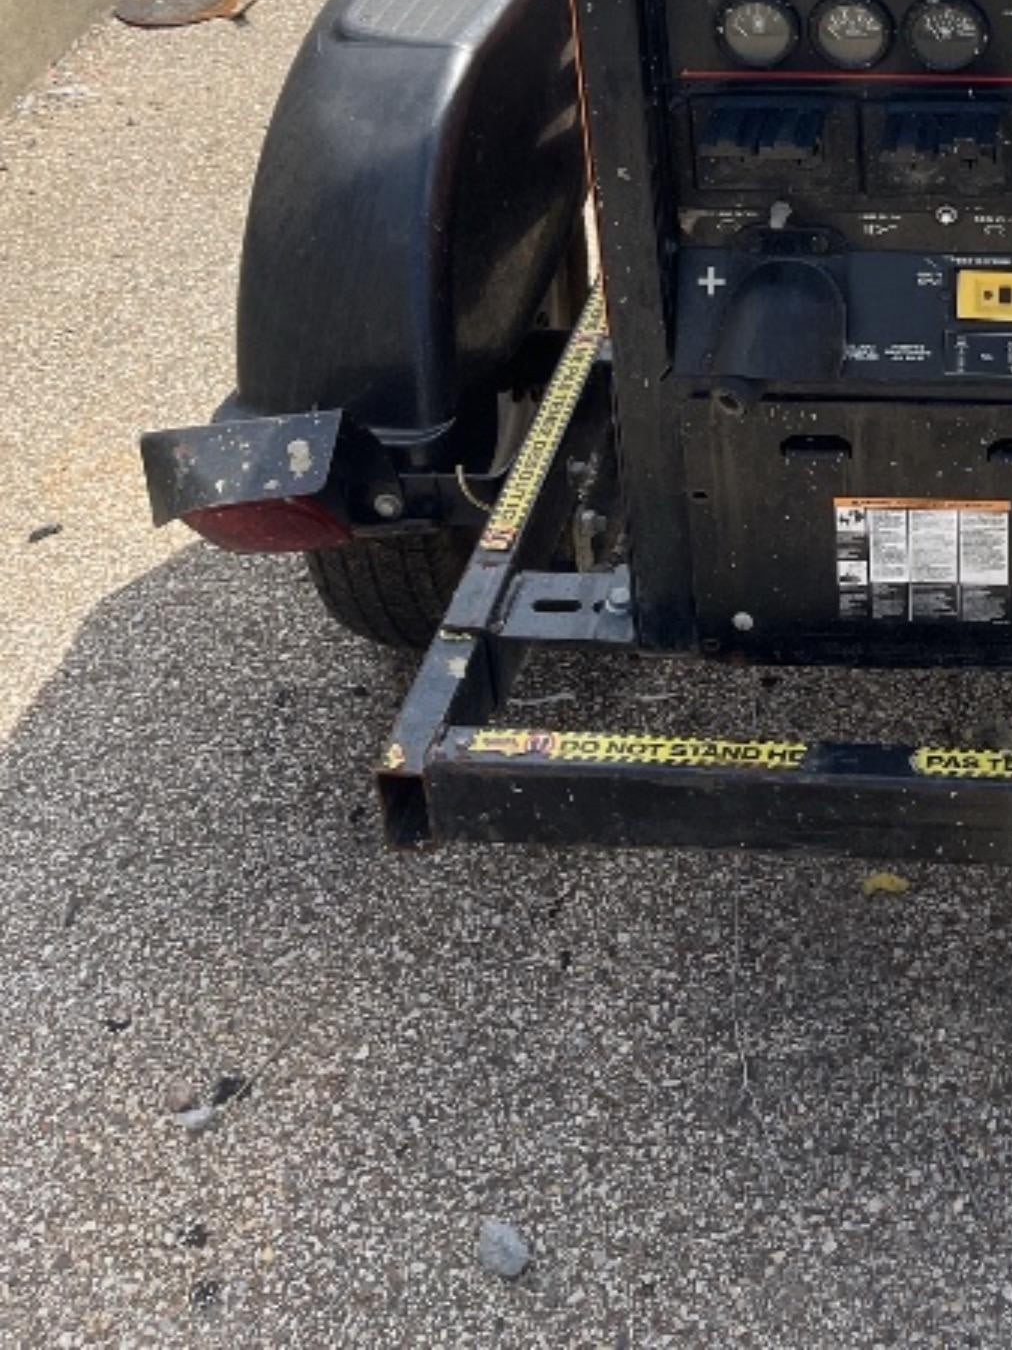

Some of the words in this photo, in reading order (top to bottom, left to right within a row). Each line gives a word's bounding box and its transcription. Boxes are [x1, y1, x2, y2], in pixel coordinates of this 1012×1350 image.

[560, 739, 599, 756] DO
[605, 741, 664, 758] NOT
[669, 744, 759, 761] STAND
[926, 755, 980, 770] PAS
